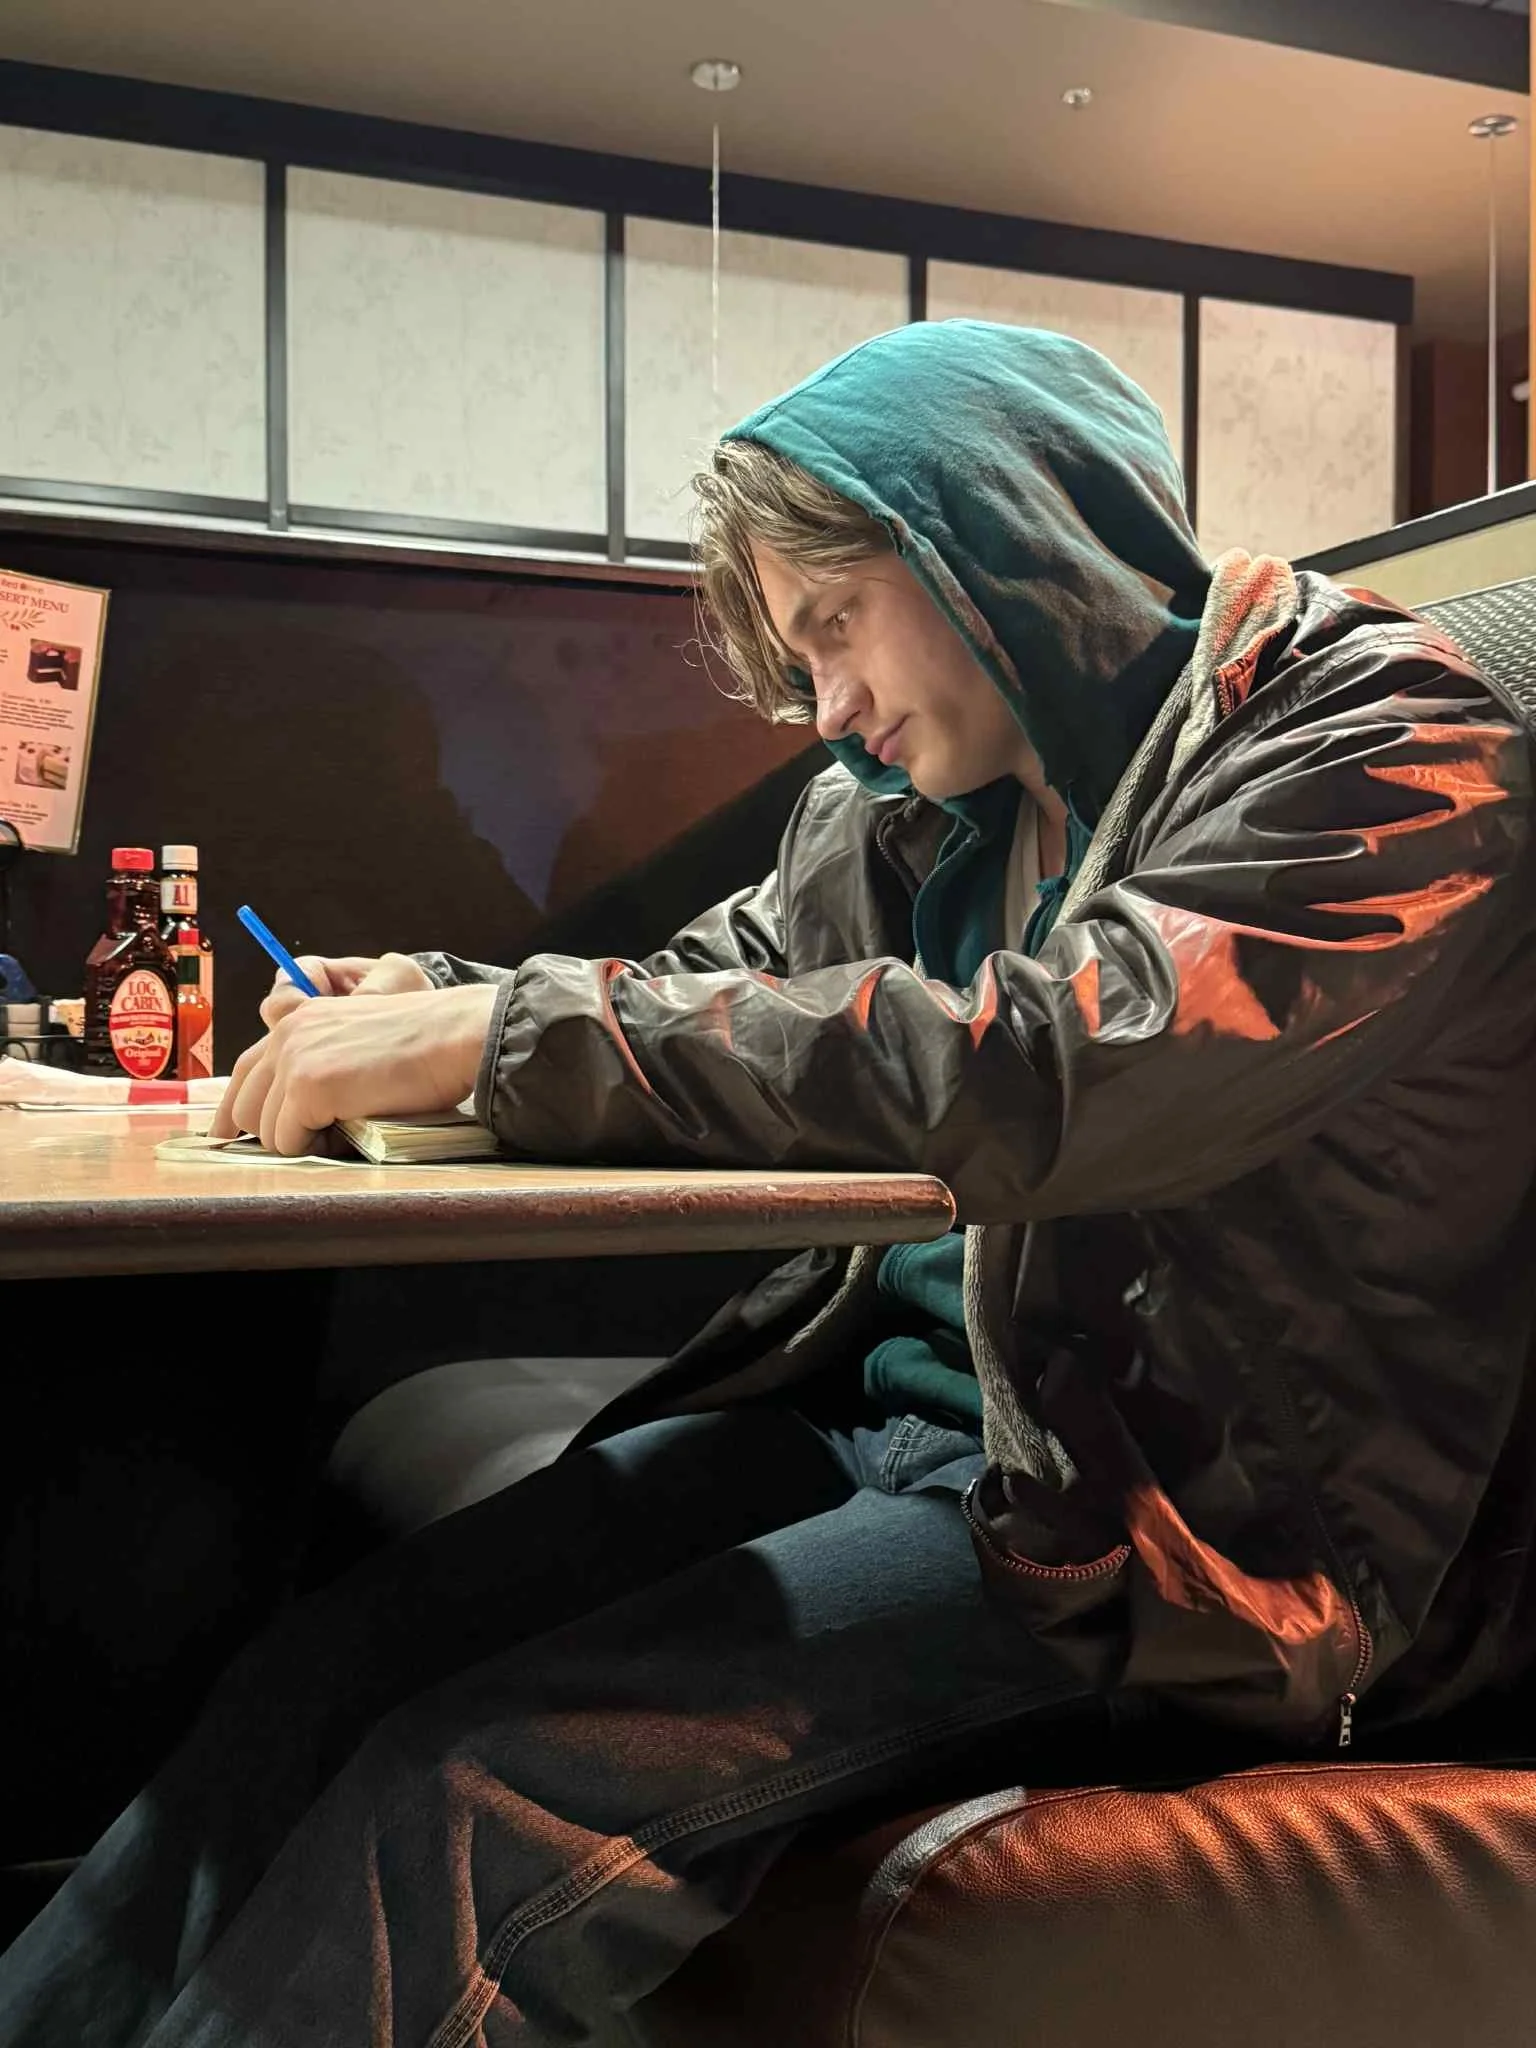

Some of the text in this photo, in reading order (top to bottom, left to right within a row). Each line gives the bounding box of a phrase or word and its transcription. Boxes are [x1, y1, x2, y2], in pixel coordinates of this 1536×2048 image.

[31, 597, 70, 614] MENU
[128, 981, 157, 996] LOG
[121, 996, 164, 1012] CABIN
